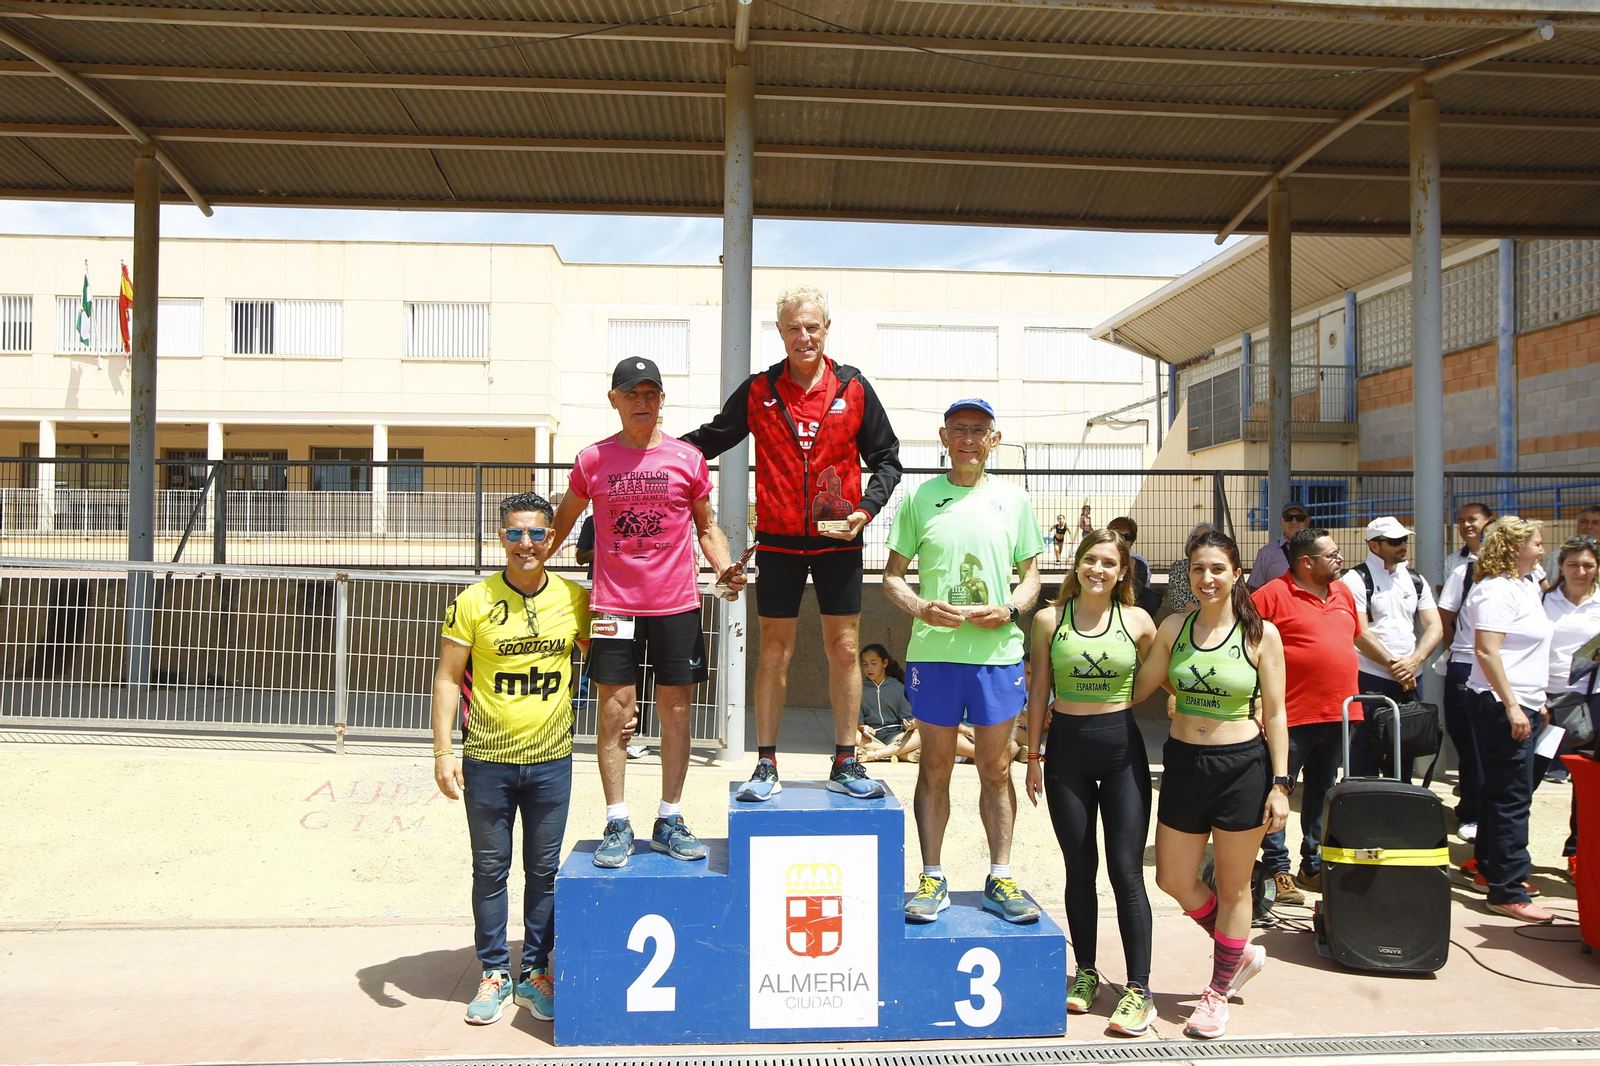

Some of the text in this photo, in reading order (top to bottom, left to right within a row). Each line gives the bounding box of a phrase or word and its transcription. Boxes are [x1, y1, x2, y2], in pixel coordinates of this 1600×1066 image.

[608, 470, 669, 482] XVI TRIATLÓN
[608, 495, 631, 503] CIUDAD
[497, 637, 566, 656] SPORTGYM
[494, 666, 562, 701] mtp
[626, 914, 677, 1012] 2
[758, 967, 870, 993] ALMERÍA
[954, 947, 1003, 1028] 3
[786, 996, 843, 1009] CIUDAD
